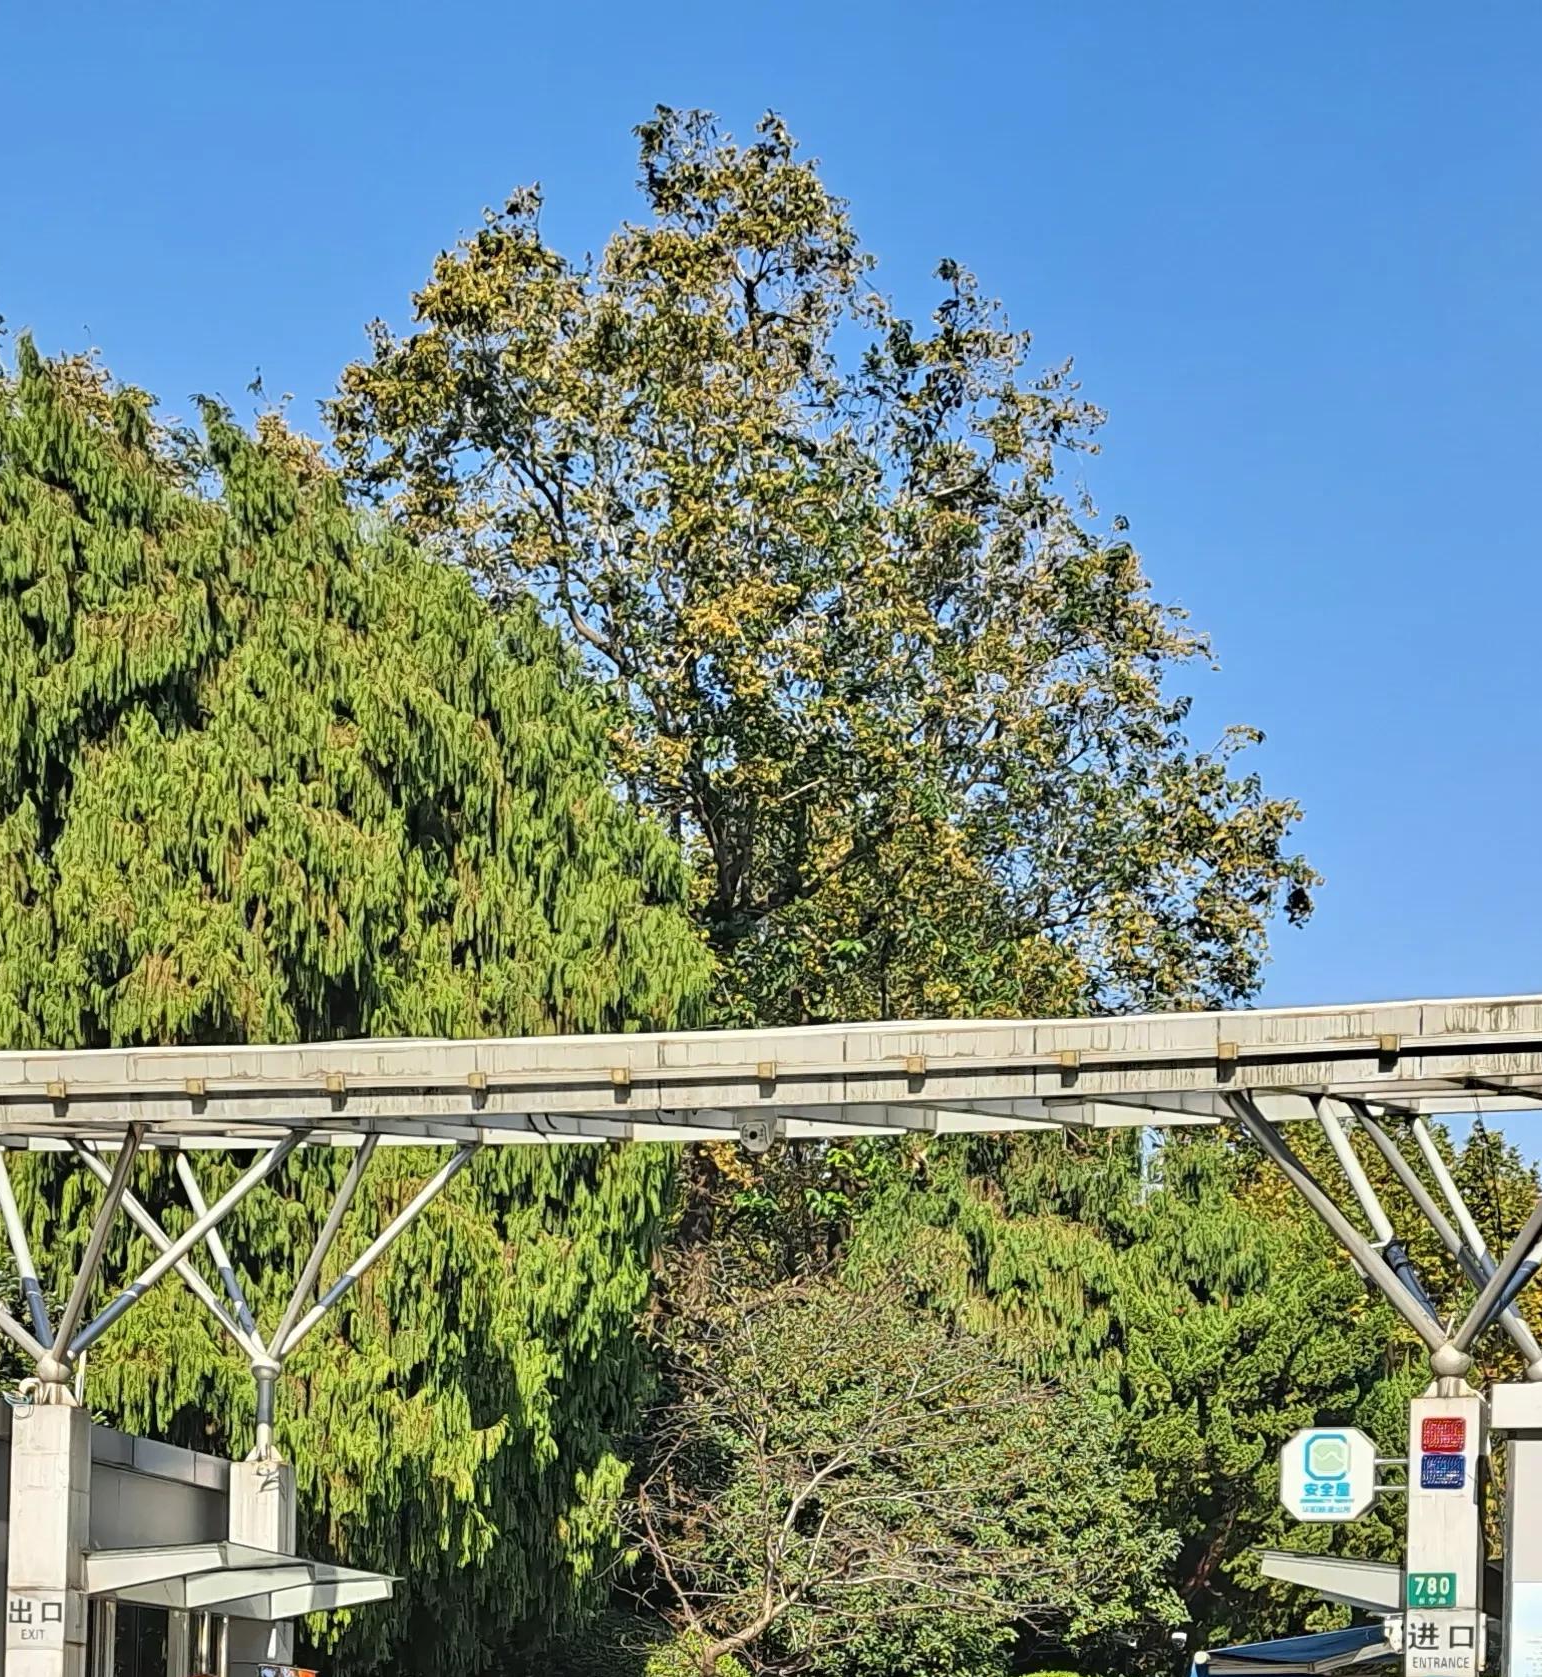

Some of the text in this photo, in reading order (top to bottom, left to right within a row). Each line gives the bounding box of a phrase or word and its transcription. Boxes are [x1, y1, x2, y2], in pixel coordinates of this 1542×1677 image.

[1304, 1482, 1351, 1497] 安全屋
[1414, 1577, 1450, 1595] 780
[9, 1599, 62, 1624] 出口
[21, 1628, 46, 1640] EXIT
[1408, 1622, 1474, 1650] 进口
[1412, 1656, 1470, 1669] ENTRANCE
